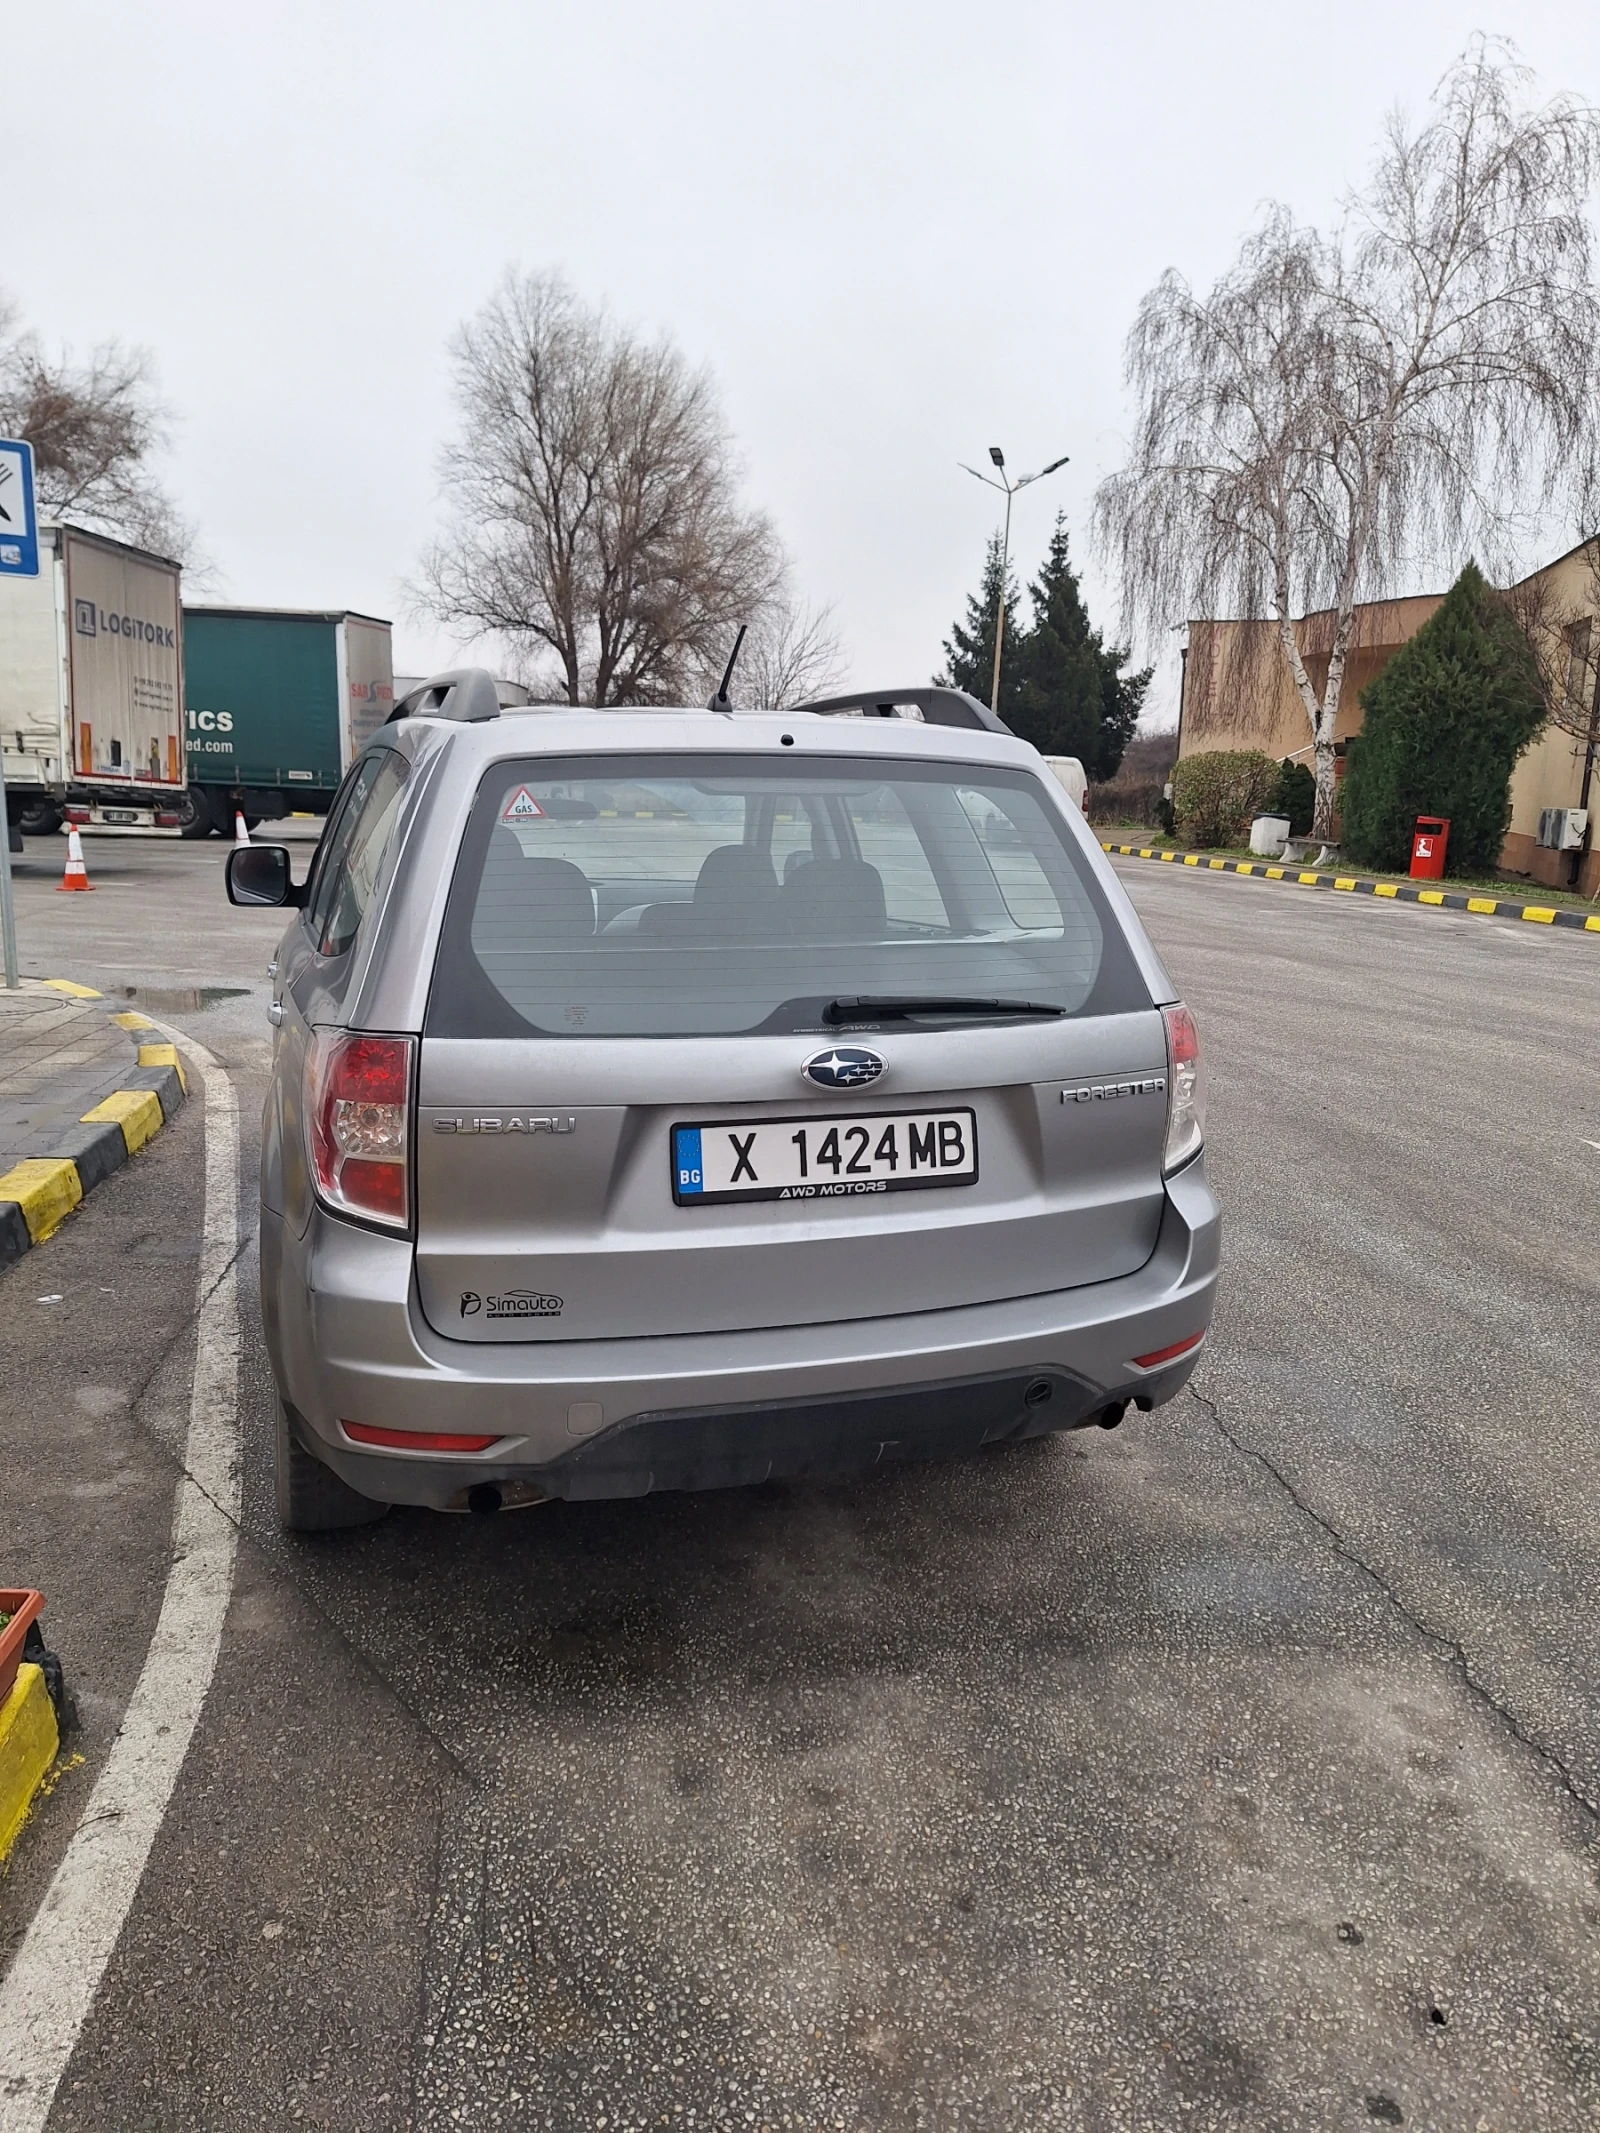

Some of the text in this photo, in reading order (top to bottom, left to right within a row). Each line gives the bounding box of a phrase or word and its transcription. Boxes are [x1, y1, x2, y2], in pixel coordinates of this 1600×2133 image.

[184, 709, 233, 732] ICS
[515, 804, 533, 813] GAS
[1060, 1078, 1165, 1104] FORESTER
[432, 1117, 576, 1134] SUBARU
[728, 1132, 759, 1183] X
[680, 1169, 701, 1185] BG
[779, 1180, 887, 1199] AWD MOTORS
[486, 1295, 559, 1312] Simauto
